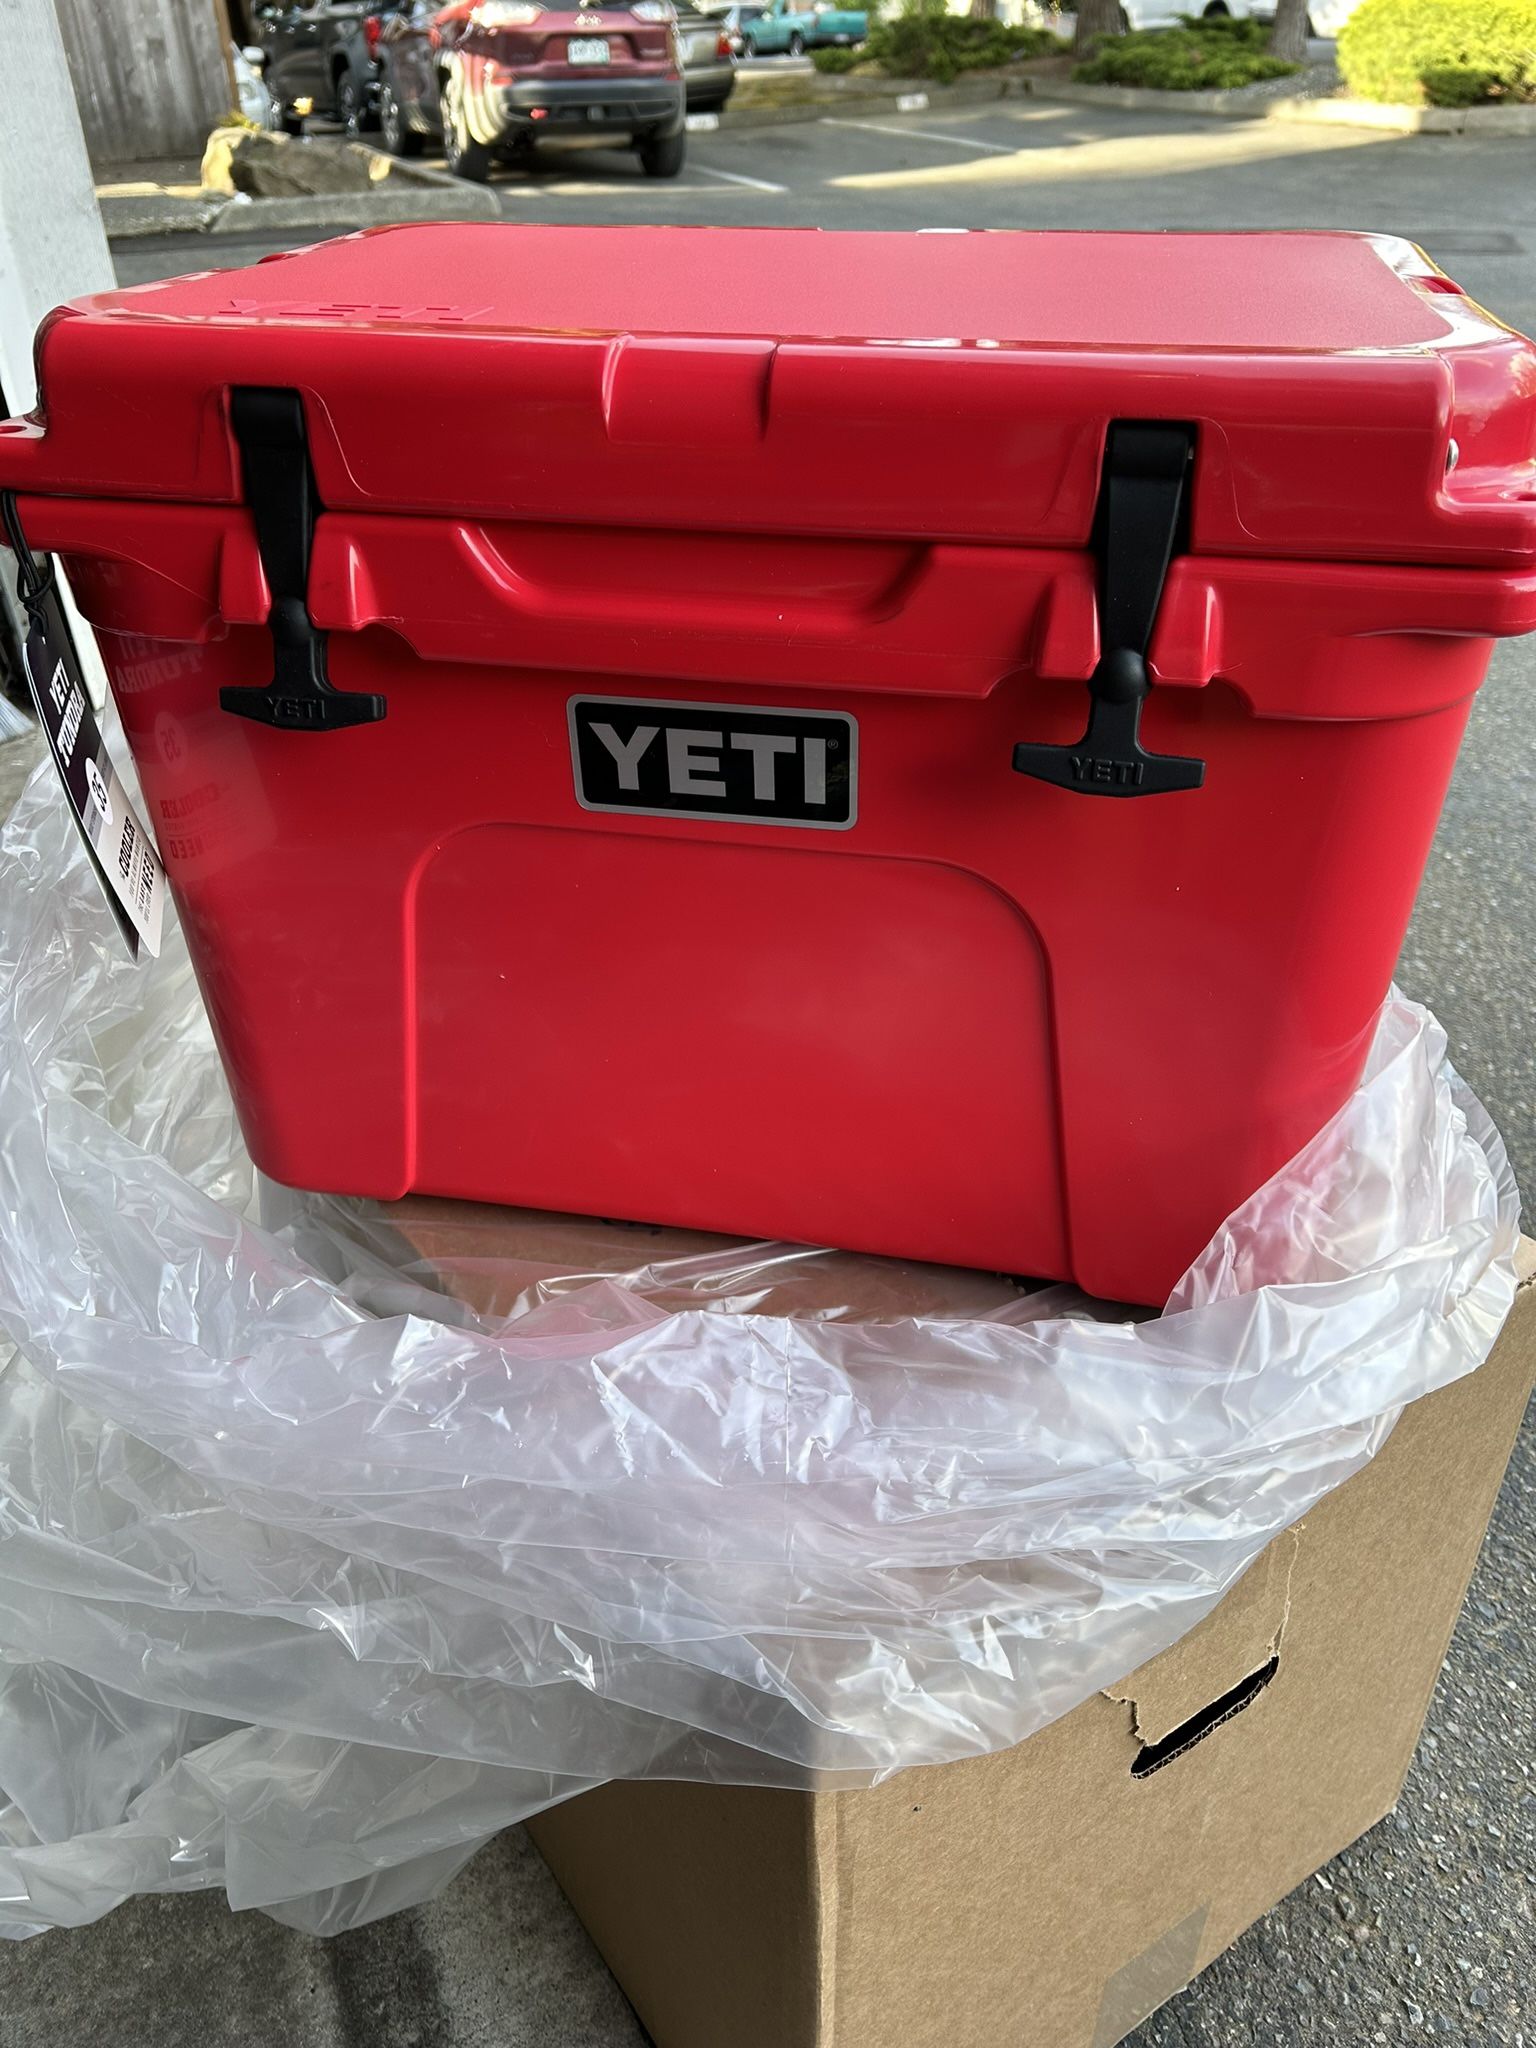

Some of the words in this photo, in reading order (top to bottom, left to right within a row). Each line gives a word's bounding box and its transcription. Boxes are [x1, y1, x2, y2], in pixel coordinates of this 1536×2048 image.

[49, 657, 70, 715] YETI
[267, 697, 326, 719] YETI
[56, 681, 86, 768] TUNDRA
[587, 721, 827, 805] YETI
[1071, 756, 1144, 785] YETI
[92, 771, 107, 812] 35
[119, 816, 135, 877] COOLER
[142, 850, 154, 894] NEED
